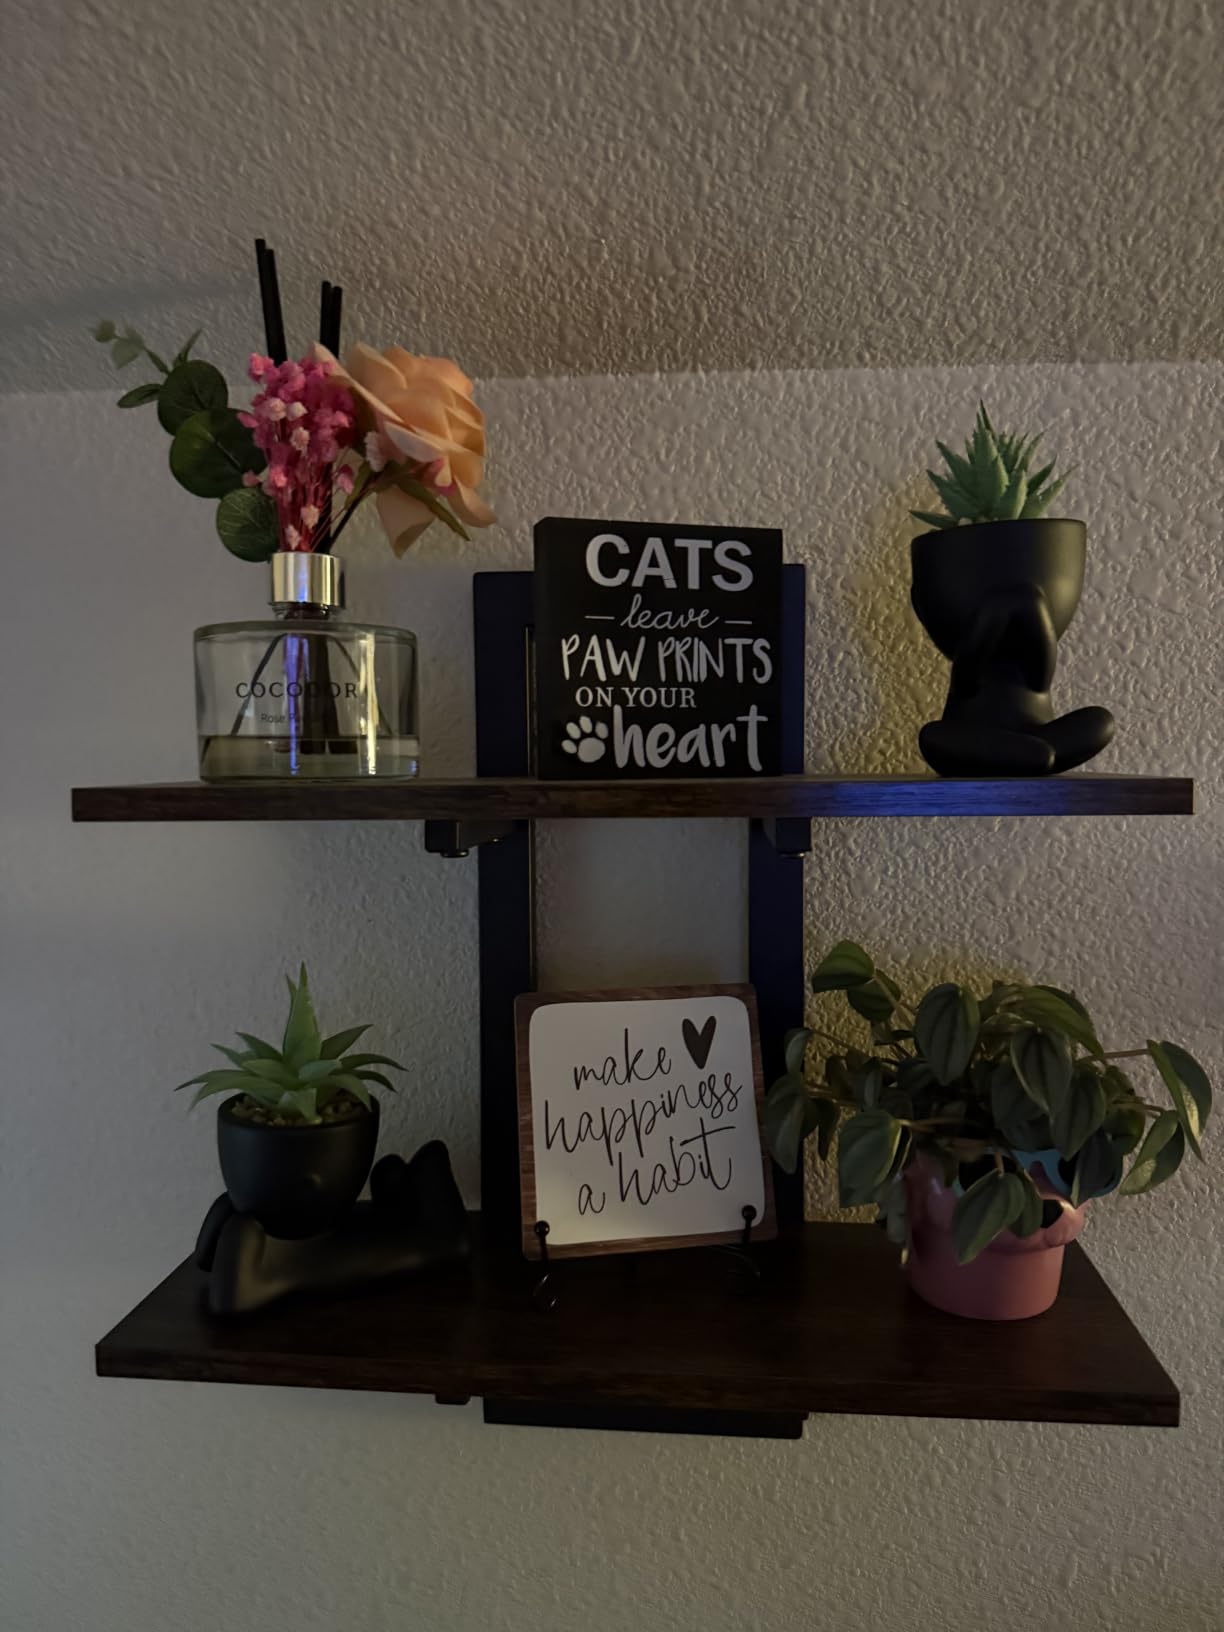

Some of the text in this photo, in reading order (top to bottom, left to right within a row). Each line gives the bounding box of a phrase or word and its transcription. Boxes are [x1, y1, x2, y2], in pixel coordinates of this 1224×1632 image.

[585, 533, 754, 592] CATS
[620, 593, 719, 629] leave
[561, 633, 773, 684] PAW PRINTS
[575, 686, 696, 708] ON YOUR
[613, 704, 769, 772] heart
[574, 1027, 672, 1091] make
[544, 1072, 743, 1166] happiness
[578, 1117, 736, 1215] a habit
